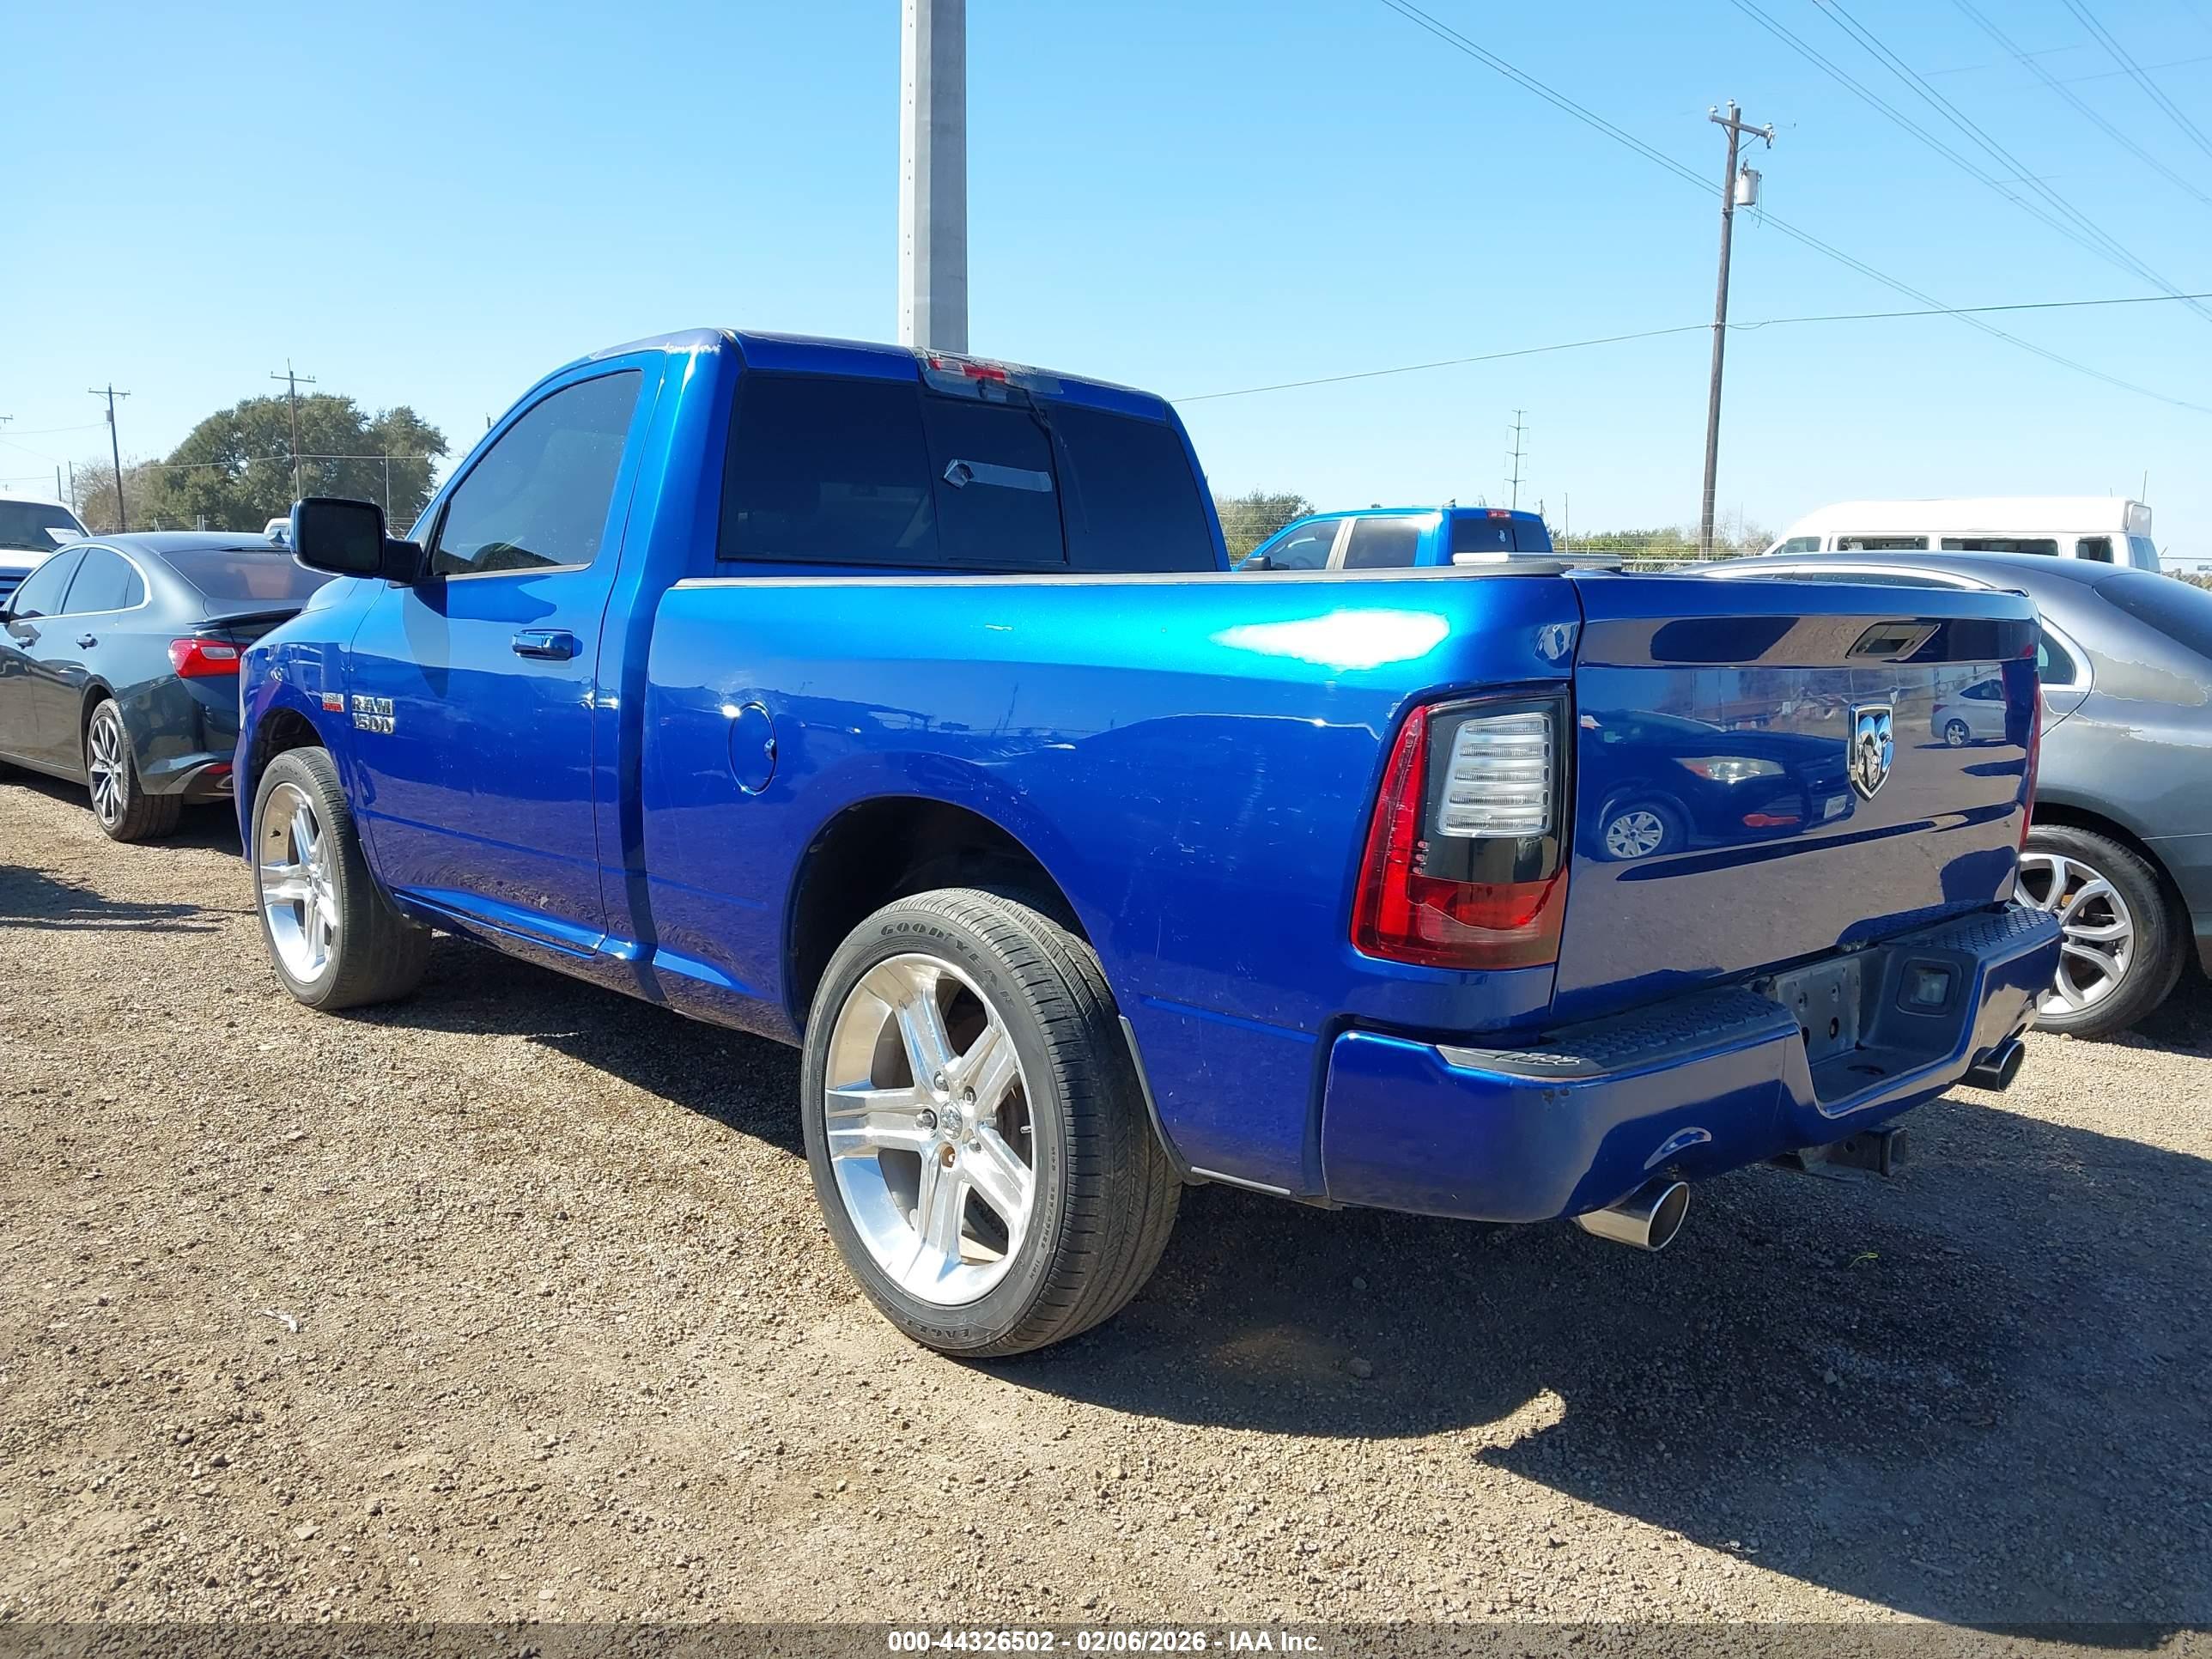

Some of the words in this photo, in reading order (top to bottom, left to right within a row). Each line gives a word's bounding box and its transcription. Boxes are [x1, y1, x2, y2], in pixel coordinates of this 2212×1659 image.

[351, 694, 394, 716] RAM
[351, 712, 396, 735] 1500
[880, 921, 1016, 1009] GOODYEAR
[903, 1316, 970, 1340] EAGLE
